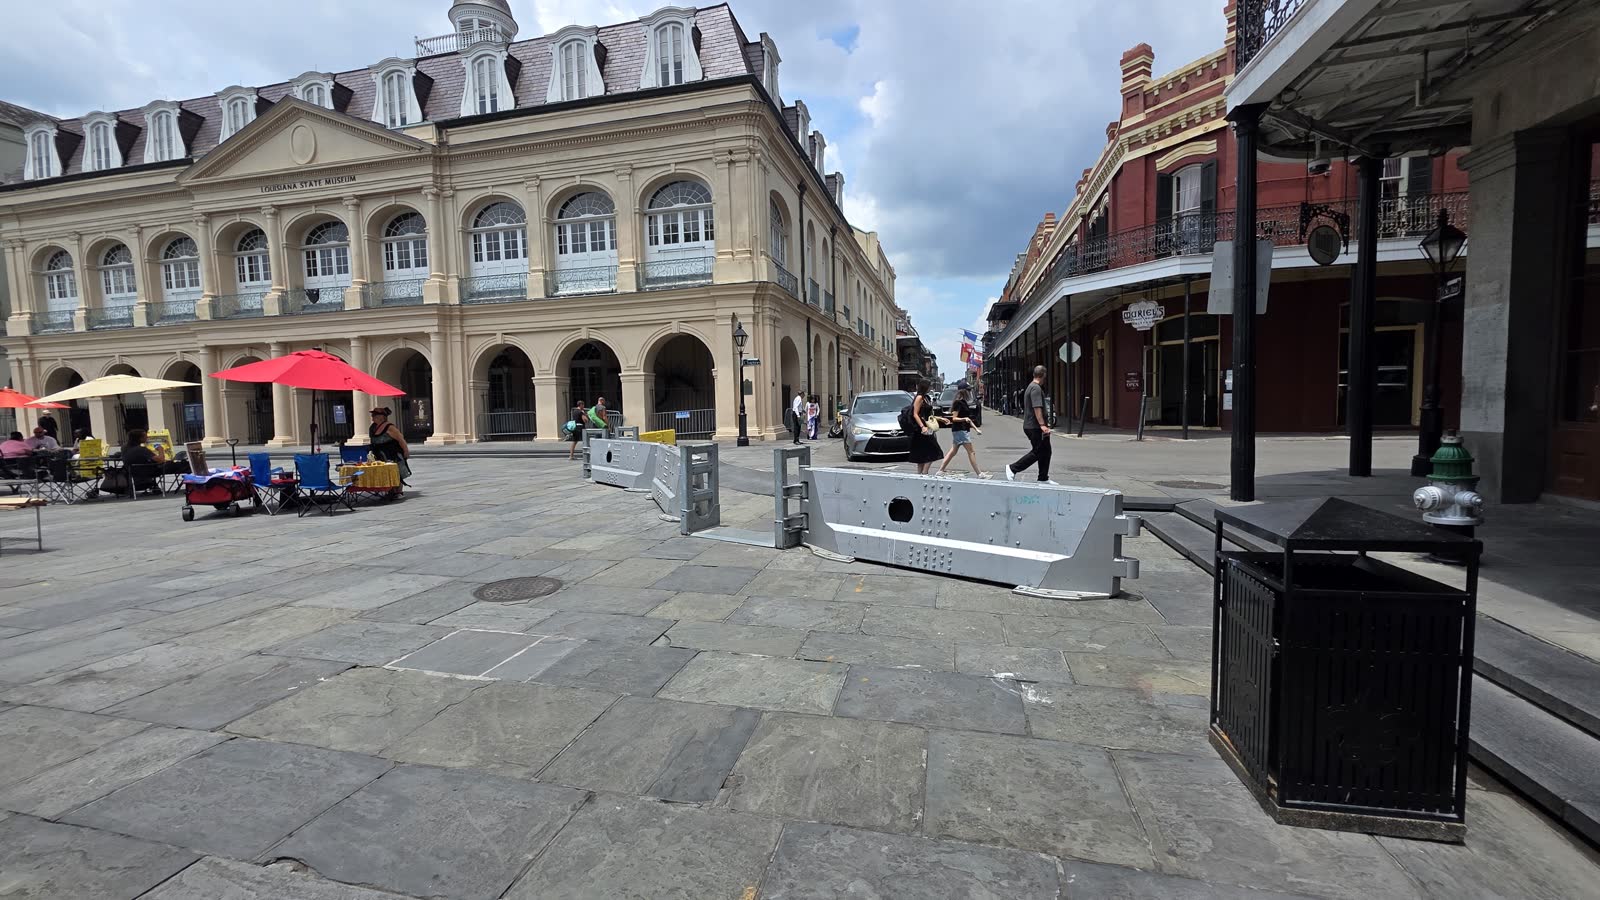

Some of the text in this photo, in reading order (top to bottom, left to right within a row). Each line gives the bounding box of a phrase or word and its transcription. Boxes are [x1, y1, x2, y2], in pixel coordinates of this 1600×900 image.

[261, 176, 356, 193] LOUISIANA STATE MUSEUM
[1123, 307, 1164, 320] MURIEL'S
